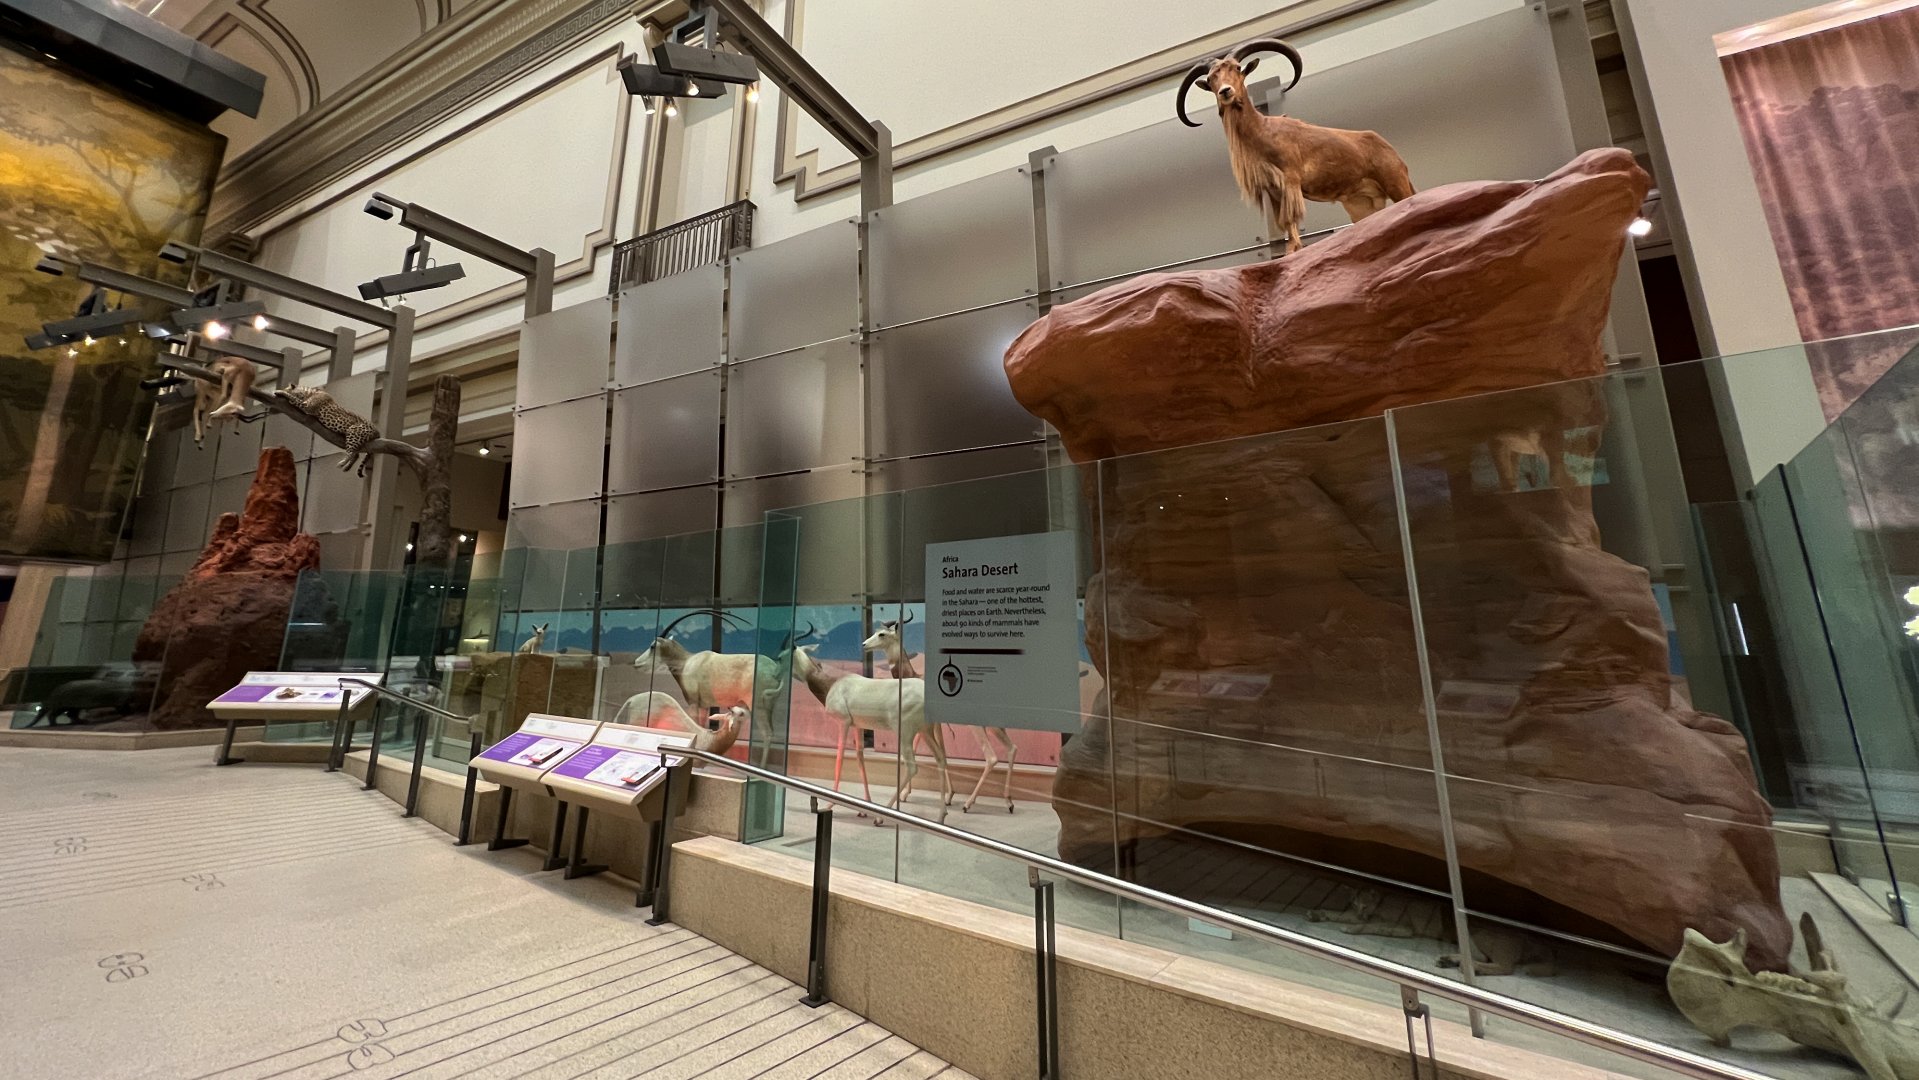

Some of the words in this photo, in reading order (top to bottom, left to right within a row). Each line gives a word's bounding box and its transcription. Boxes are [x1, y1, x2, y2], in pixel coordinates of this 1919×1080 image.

[942, 566, 978, 578] Sahara
[982, 563, 1018, 576] Desert
[1016, 584, 1050, 594] year-round
[959, 609, 976, 617] places
